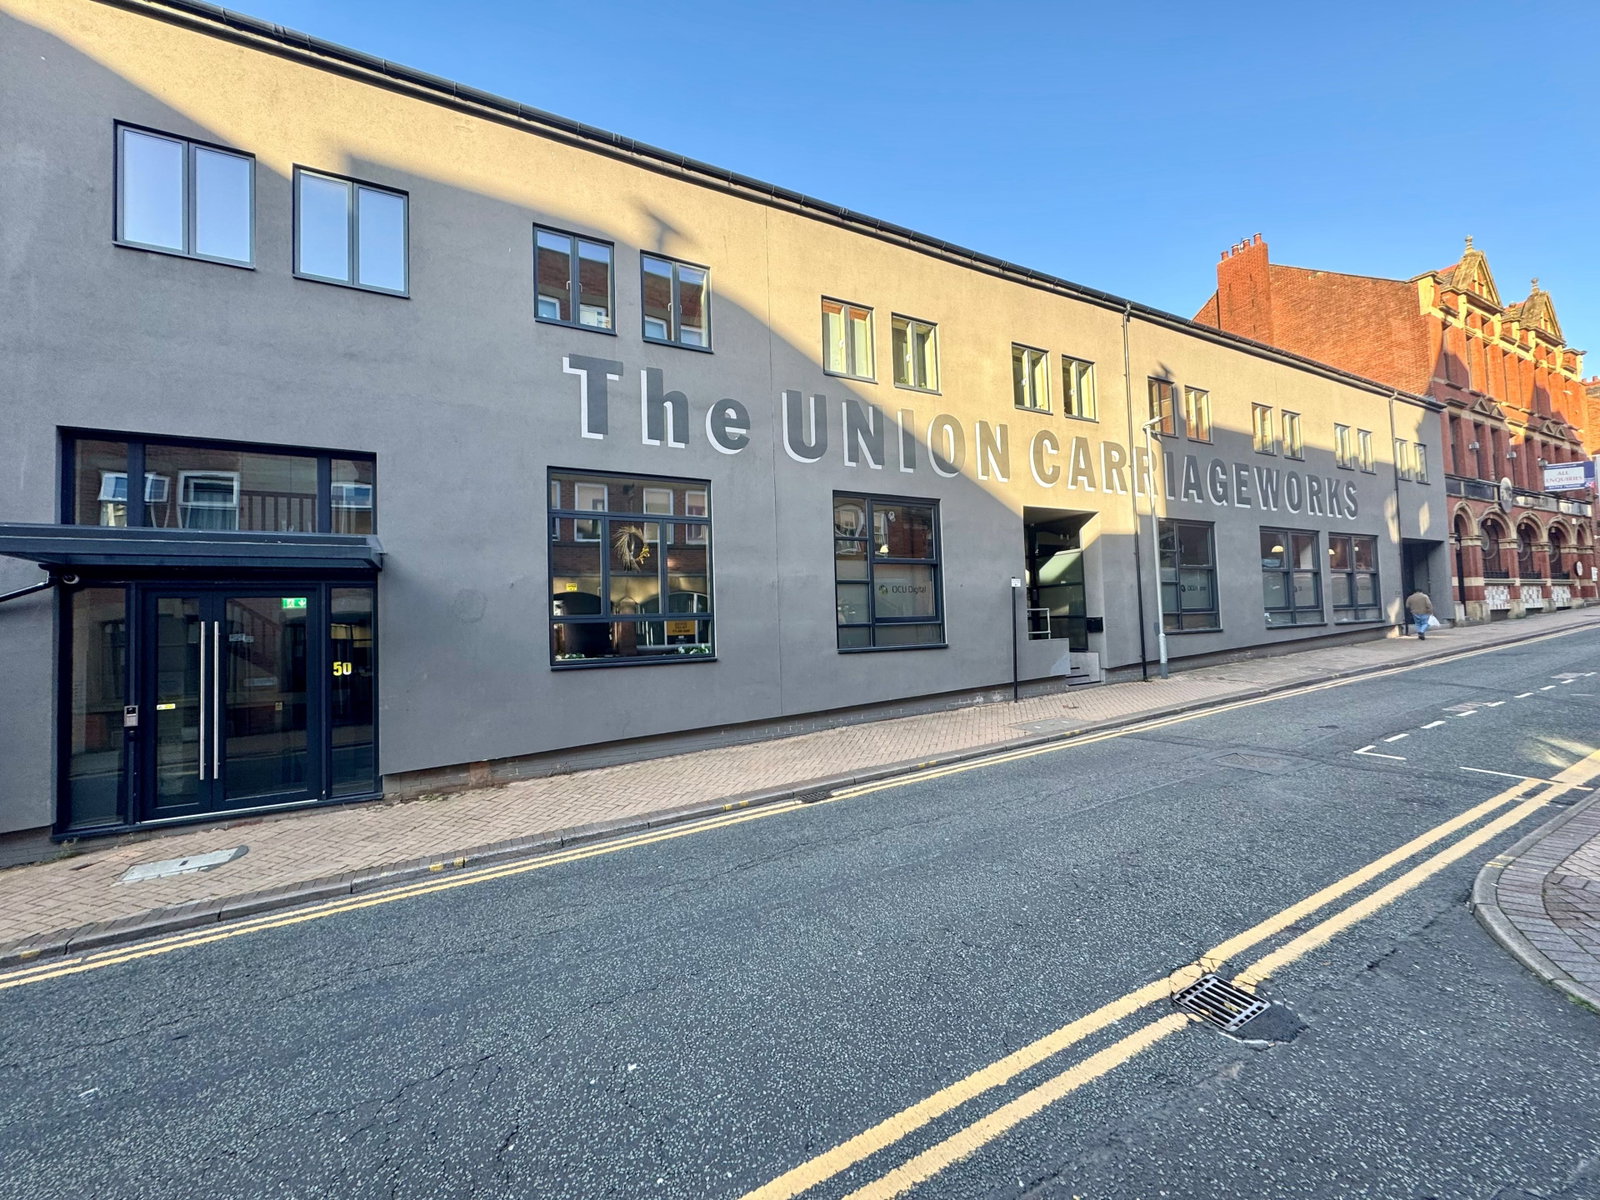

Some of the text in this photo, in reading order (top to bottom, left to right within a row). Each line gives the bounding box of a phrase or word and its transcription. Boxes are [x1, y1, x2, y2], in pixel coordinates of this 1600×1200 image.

[562, 353, 1359, 520] The UNION CARRIAGEWORKS
[892, 585, 926, 594] OCU Digital
[333, 661, 352, 677] 50
